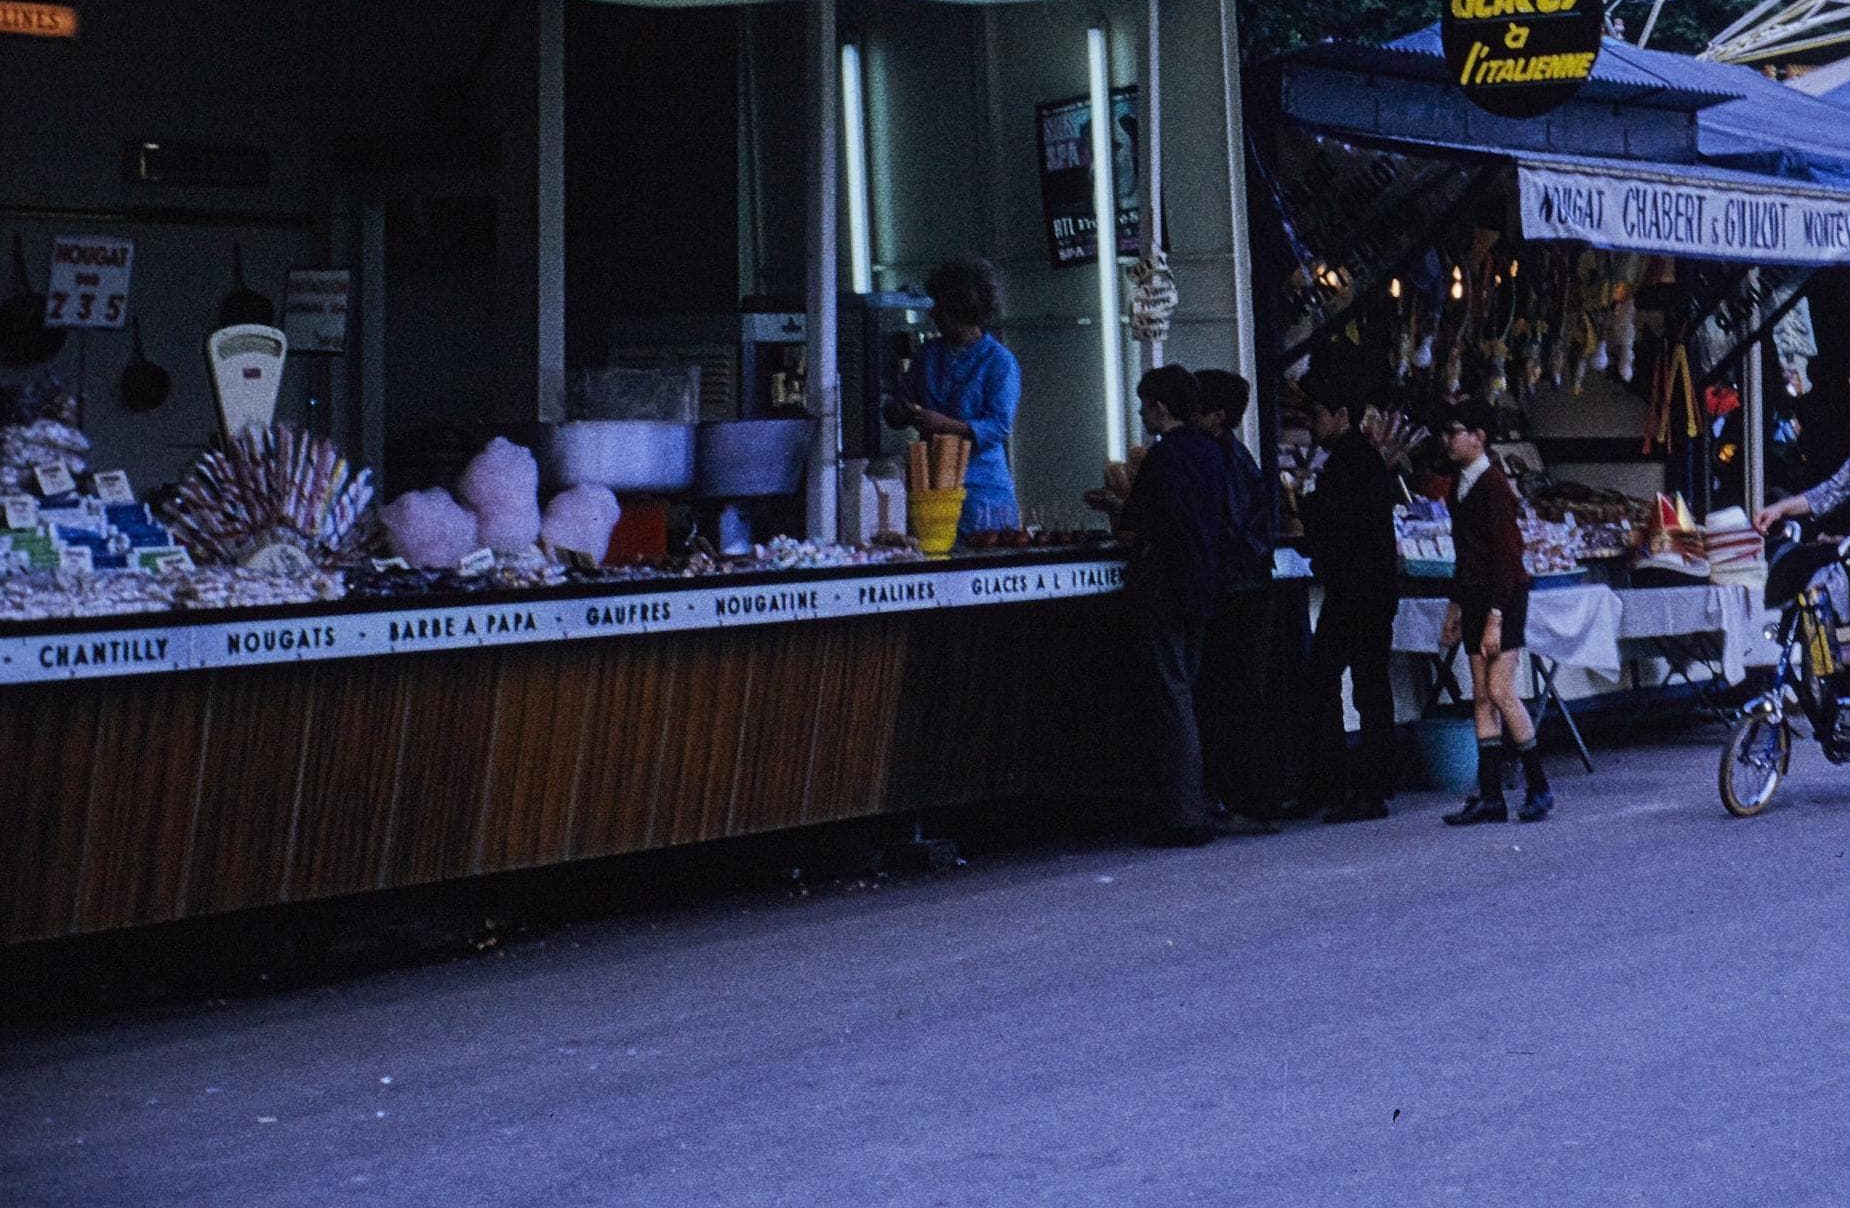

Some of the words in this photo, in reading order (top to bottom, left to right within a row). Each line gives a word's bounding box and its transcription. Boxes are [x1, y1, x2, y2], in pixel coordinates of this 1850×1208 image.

[1539, 183, 1606, 230] NOUGAT
[1622, 185, 1707, 244] CHABERT
[1724, 198, 1790, 250] GUILLOT
[55, 243, 129, 267] NOUGAT
[39, 637, 169, 668] CHANTILLY
[226, 626, 336, 655] NOUGATS
[389, 616, 455, 641] BARBE
[463, 615, 477, 635] A
[486, 612, 537, 634] PAPA
[585, 601, 672, 626] GAUFRES
[715, 590, 819, 616] NOUGATINE
[859, 581, 936, 605] PRALINES
[970, 574, 1028, 596] GLACES
[1036, 572, 1045, 590] A
